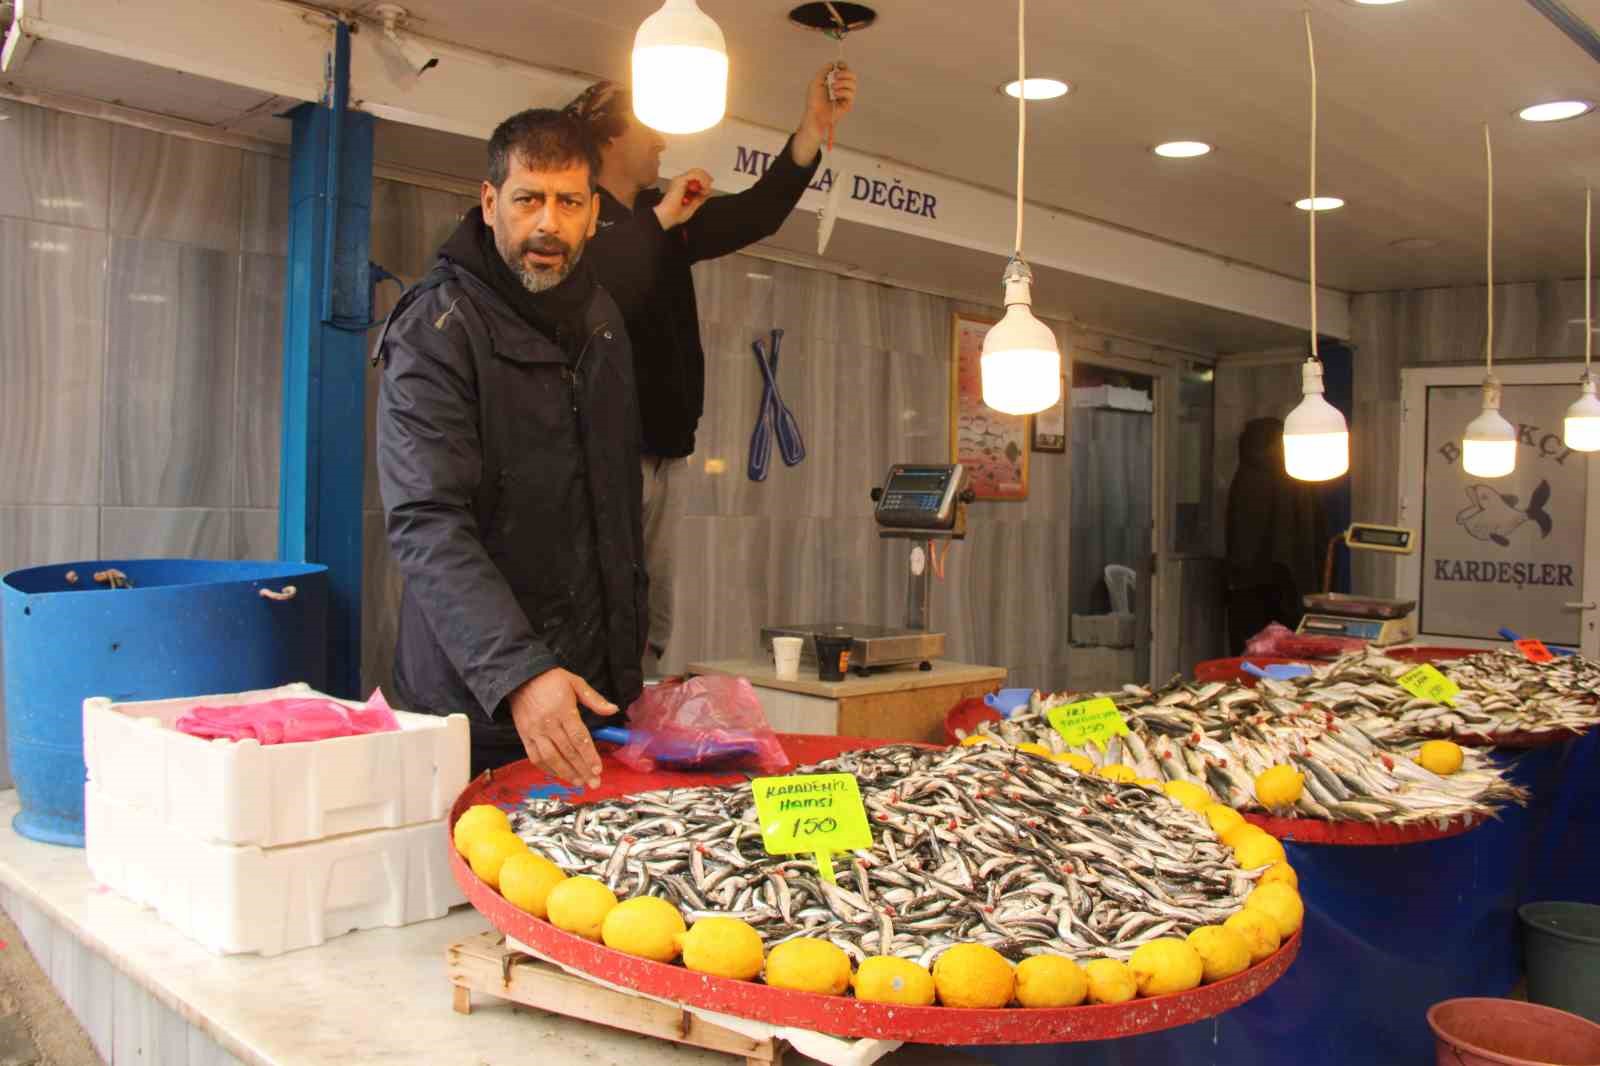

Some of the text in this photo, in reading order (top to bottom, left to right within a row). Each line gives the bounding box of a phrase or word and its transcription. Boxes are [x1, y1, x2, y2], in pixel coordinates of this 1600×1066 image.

[851, 175, 937, 219] DEĞER
[1434, 559, 1575, 591] KARDEŞLER
[793, 817, 838, 838] 150
